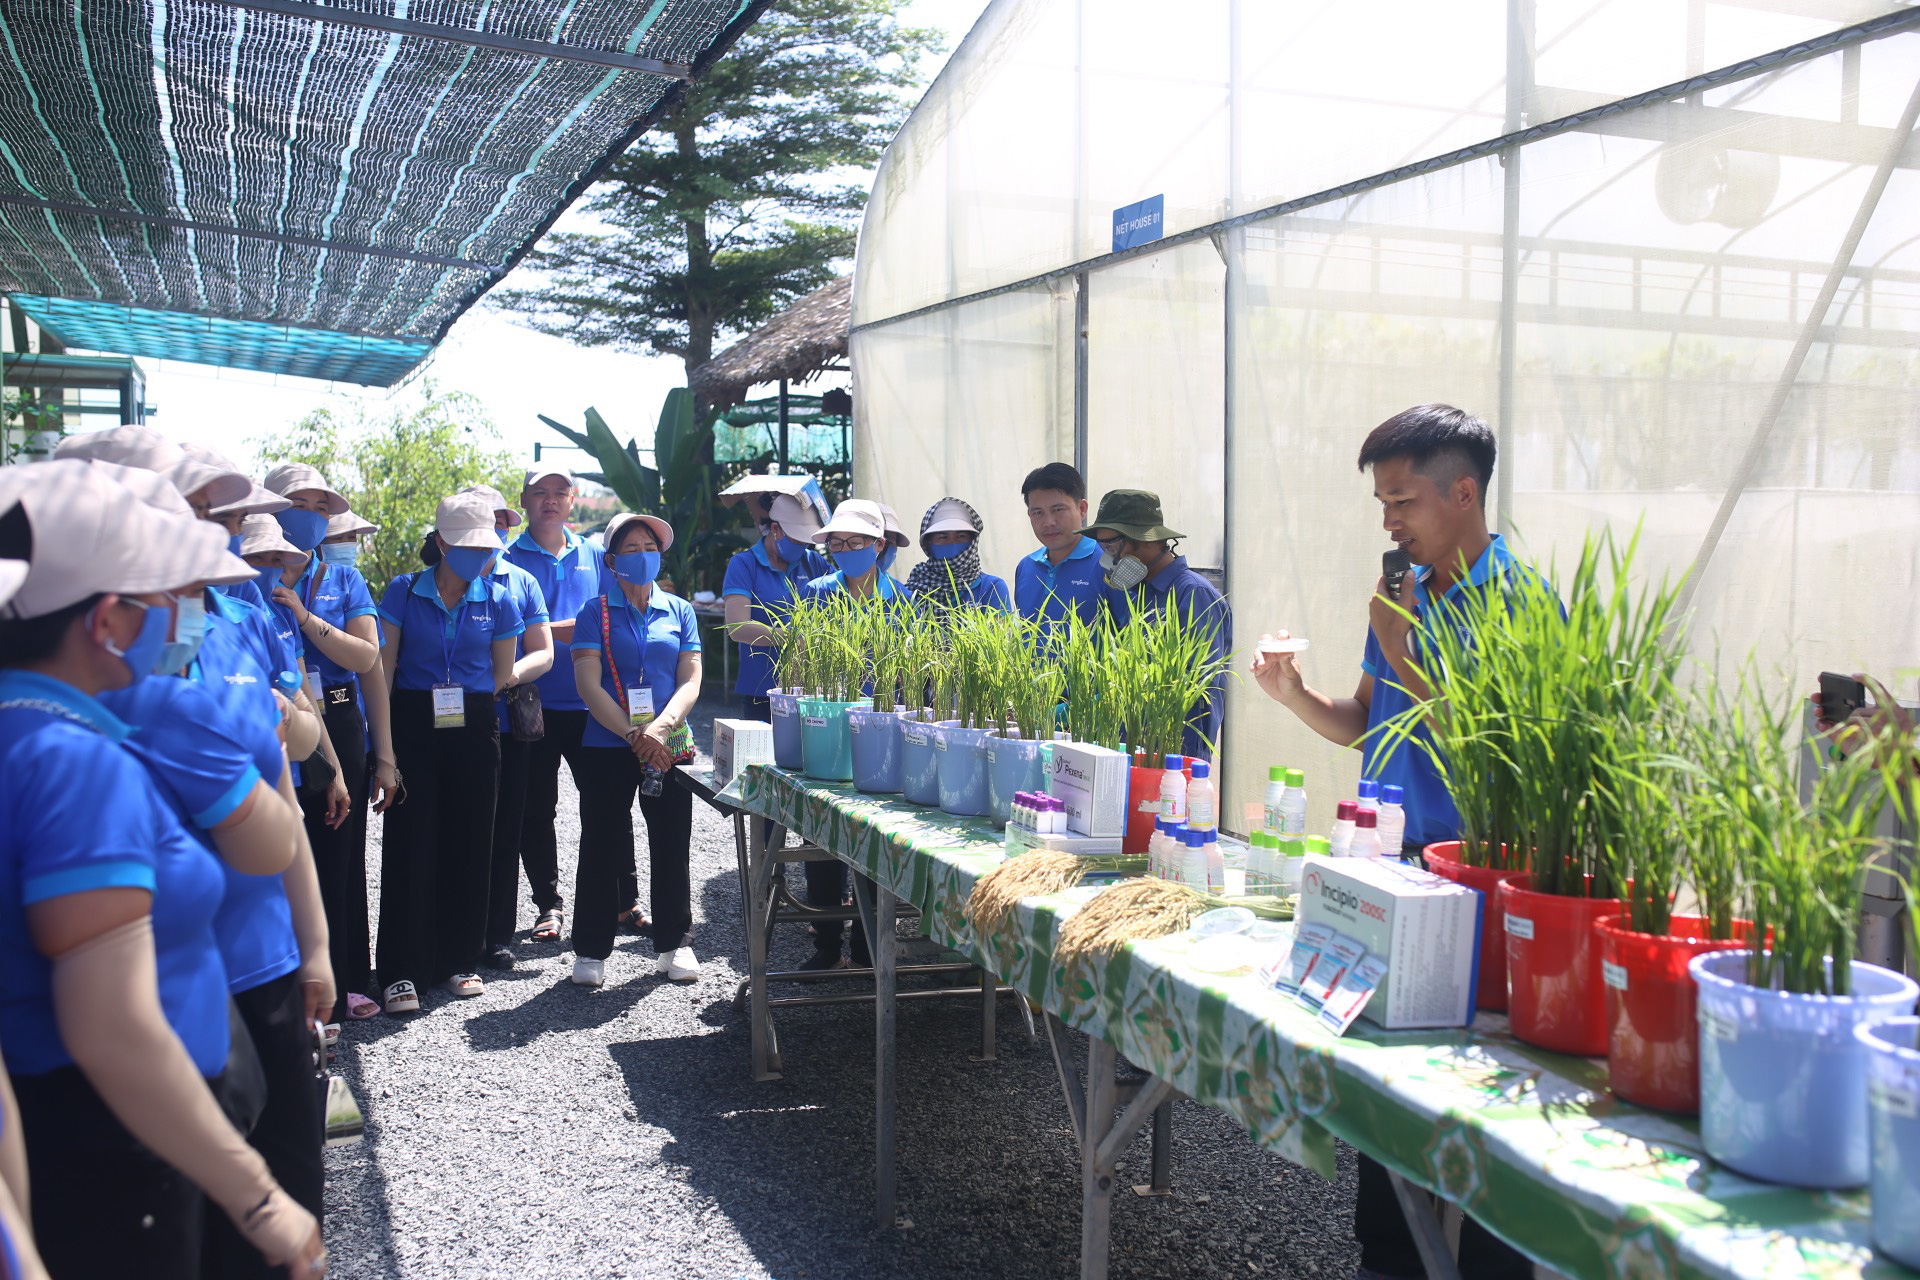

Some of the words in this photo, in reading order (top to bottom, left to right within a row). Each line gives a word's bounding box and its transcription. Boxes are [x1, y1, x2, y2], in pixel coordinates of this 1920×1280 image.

[1115, 222, 1129, 236] NET
[1130, 214, 1152, 232] HOUSE
[1153, 211, 1160, 224] 01
[1065, 764, 1083, 780] Pexena
[1320, 879, 1358, 910] Incipio
